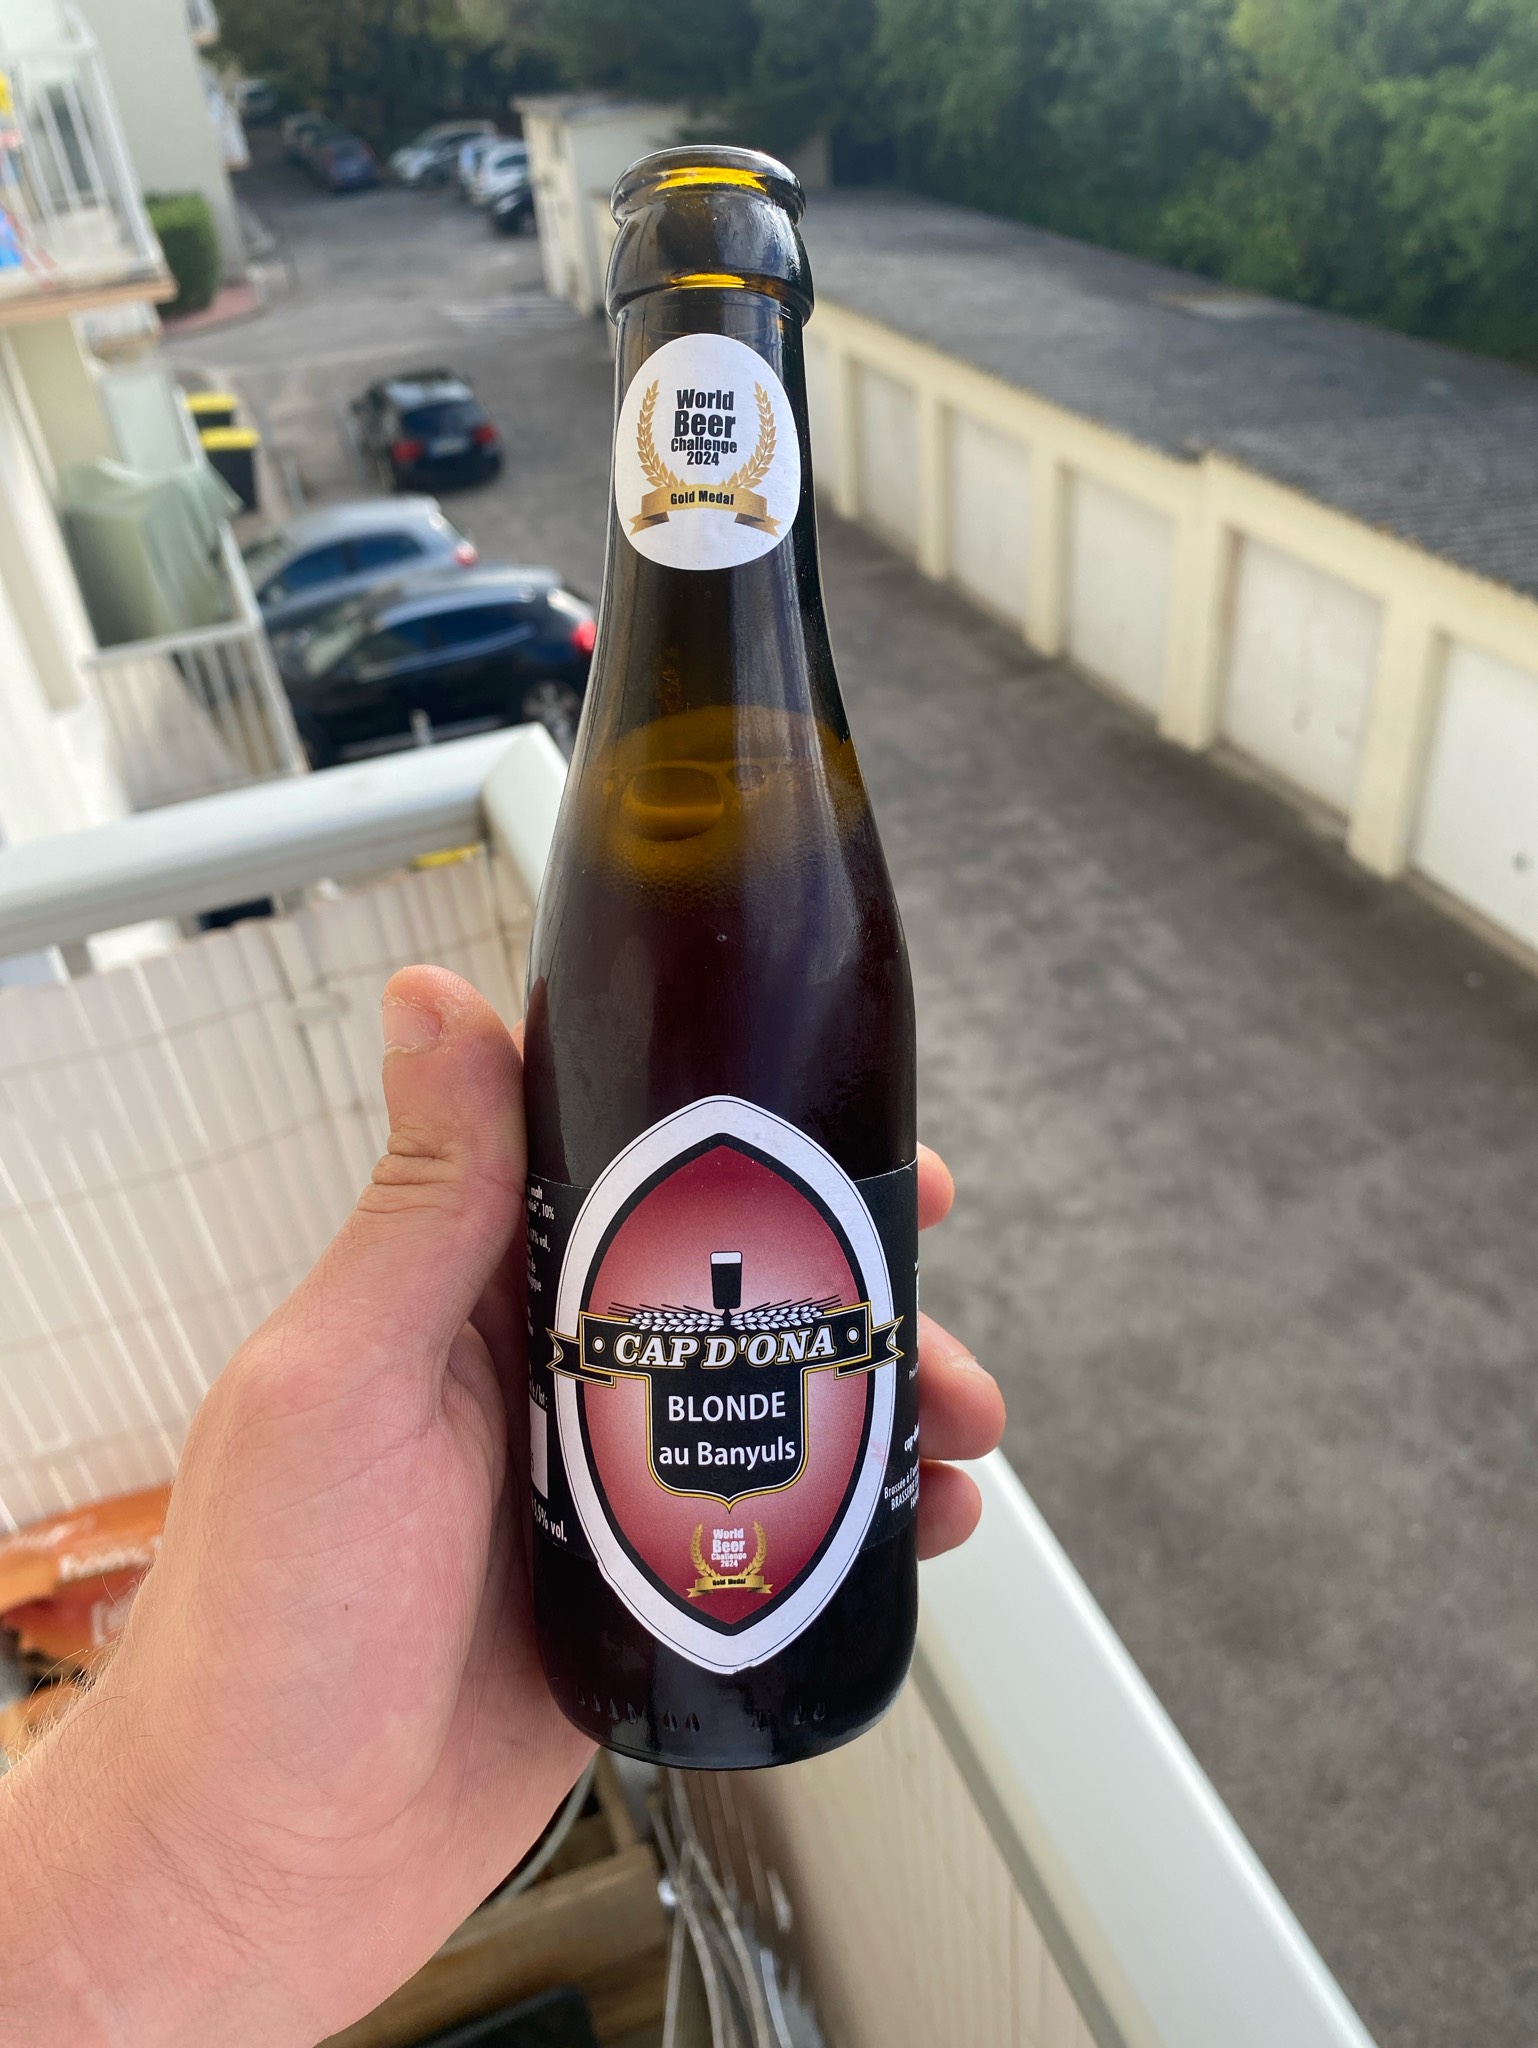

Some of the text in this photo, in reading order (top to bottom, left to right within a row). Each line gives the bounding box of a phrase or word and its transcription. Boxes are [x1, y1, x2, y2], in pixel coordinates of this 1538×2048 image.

[676, 389, 735, 411] World
[674, 410, 736, 438] Beer
[670, 437, 738, 454] Challenge
[686, 451, 720, 466] 2024
[670, 490, 735, 505] Gold Medal
[542, 1203, 555, 1220] 10%
[615, 1325, 837, 1369] CAP D'ONA
[667, 1391, 786, 1422] BLONDE
[658, 1436, 796, 1471] au Banyuls
[550, 1520, 568, 1542] vol.
[712, 1528, 744, 1539] World
[712, 1539, 746, 1553] Beer
[720, 1559, 739, 1567] 2024
